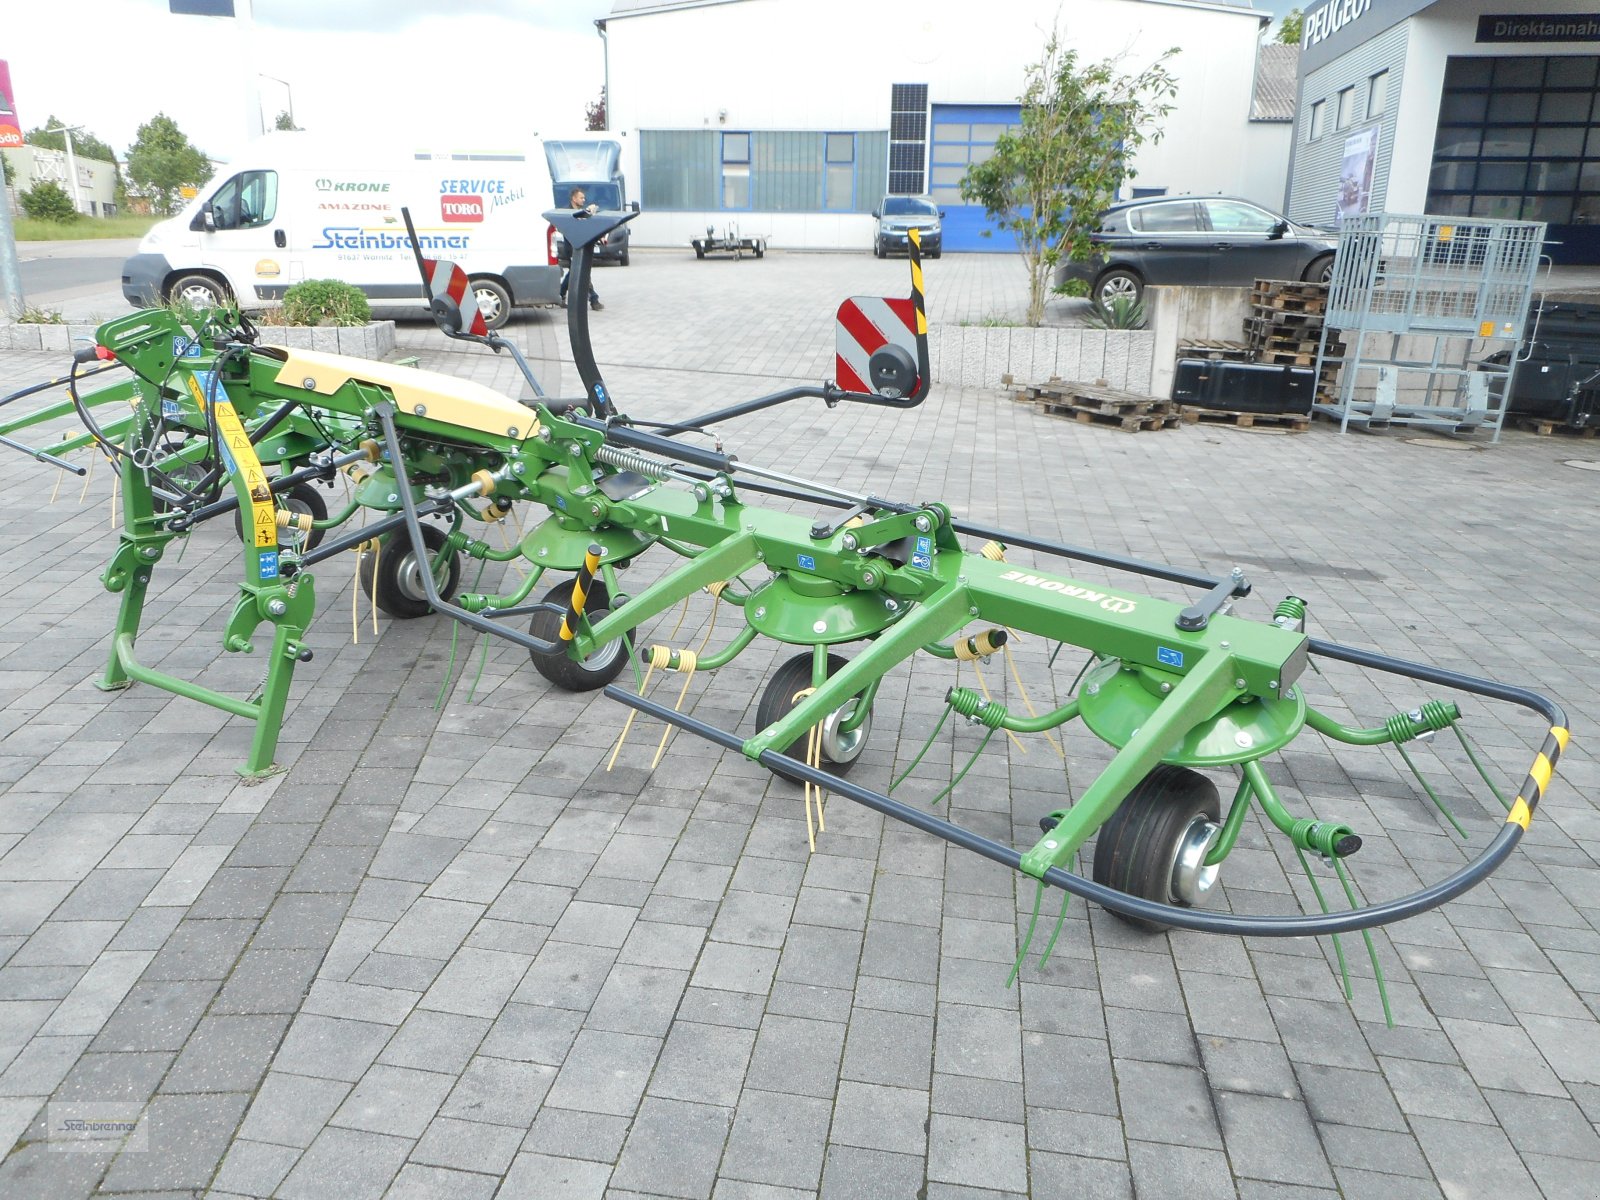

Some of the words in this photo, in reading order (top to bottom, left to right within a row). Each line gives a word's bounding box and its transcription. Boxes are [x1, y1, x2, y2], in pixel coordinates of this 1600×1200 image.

[1494, 21, 1600, 36] Direktannah
[334, 182, 391, 193] KRONE
[440, 179, 505, 194] SERVICE
[318, 203, 391, 211] AMAZONE
[490, 187, 525, 214] Mobil
[443, 203, 482, 215] TORO
[999, 570, 1104, 602] KRONE
